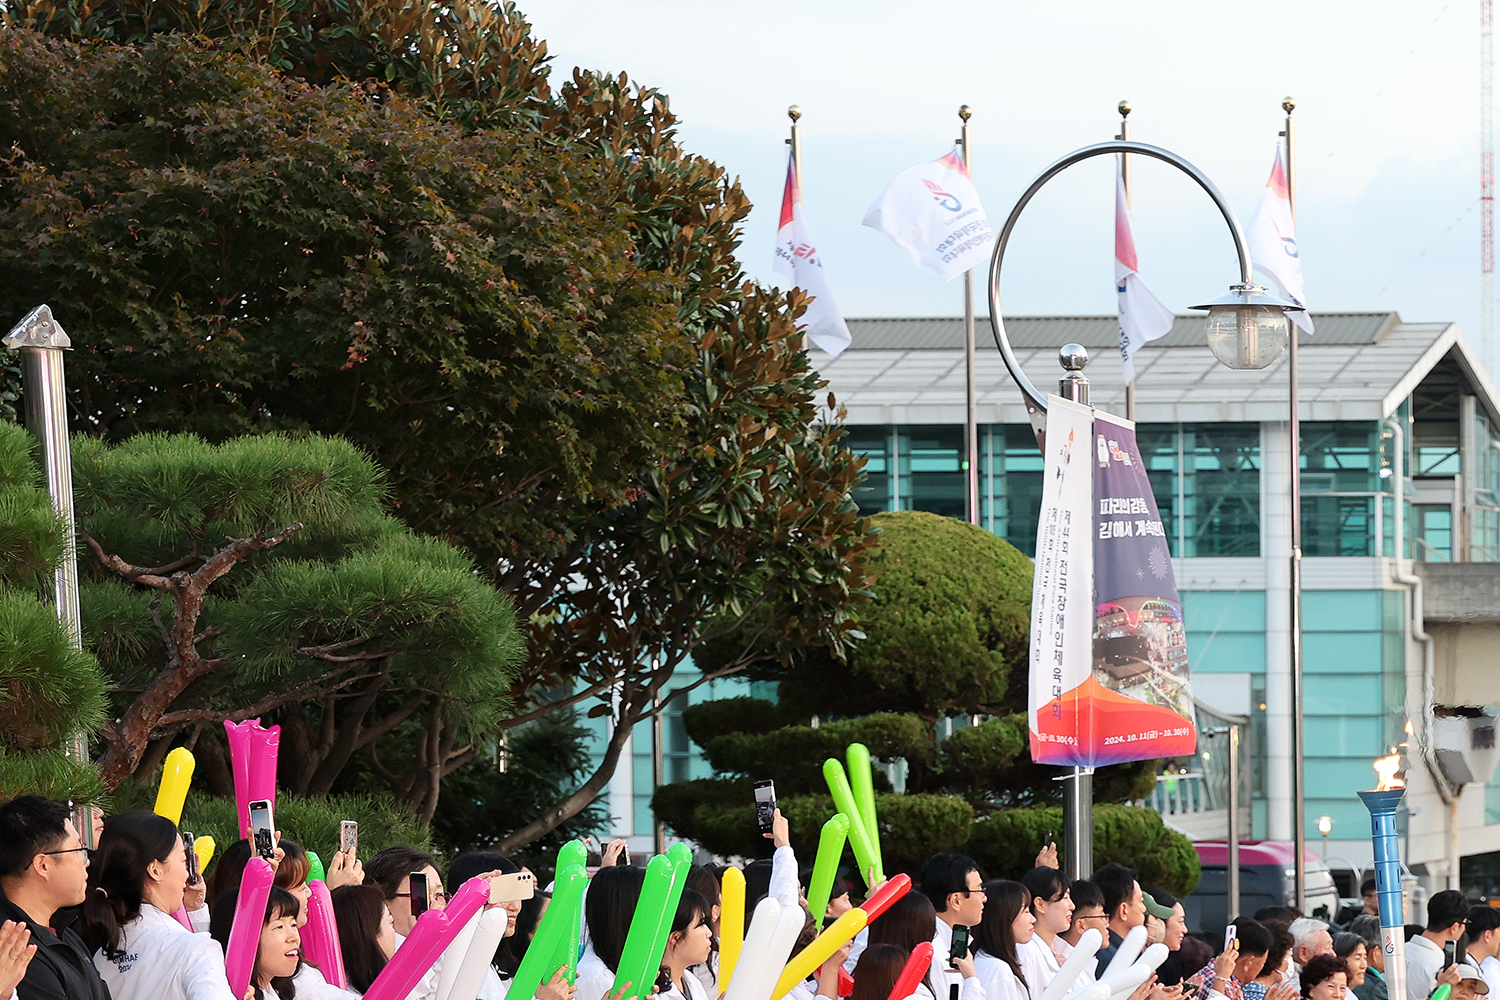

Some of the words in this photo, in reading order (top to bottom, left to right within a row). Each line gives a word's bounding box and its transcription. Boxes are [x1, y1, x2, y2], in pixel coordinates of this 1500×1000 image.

[1099, 520, 1133, 539] 김해서
[1104, 737, 1126, 746] 2024.
[1127, 735, 1138, 743] 10.
[1163, 729, 1173, 738] 10.
